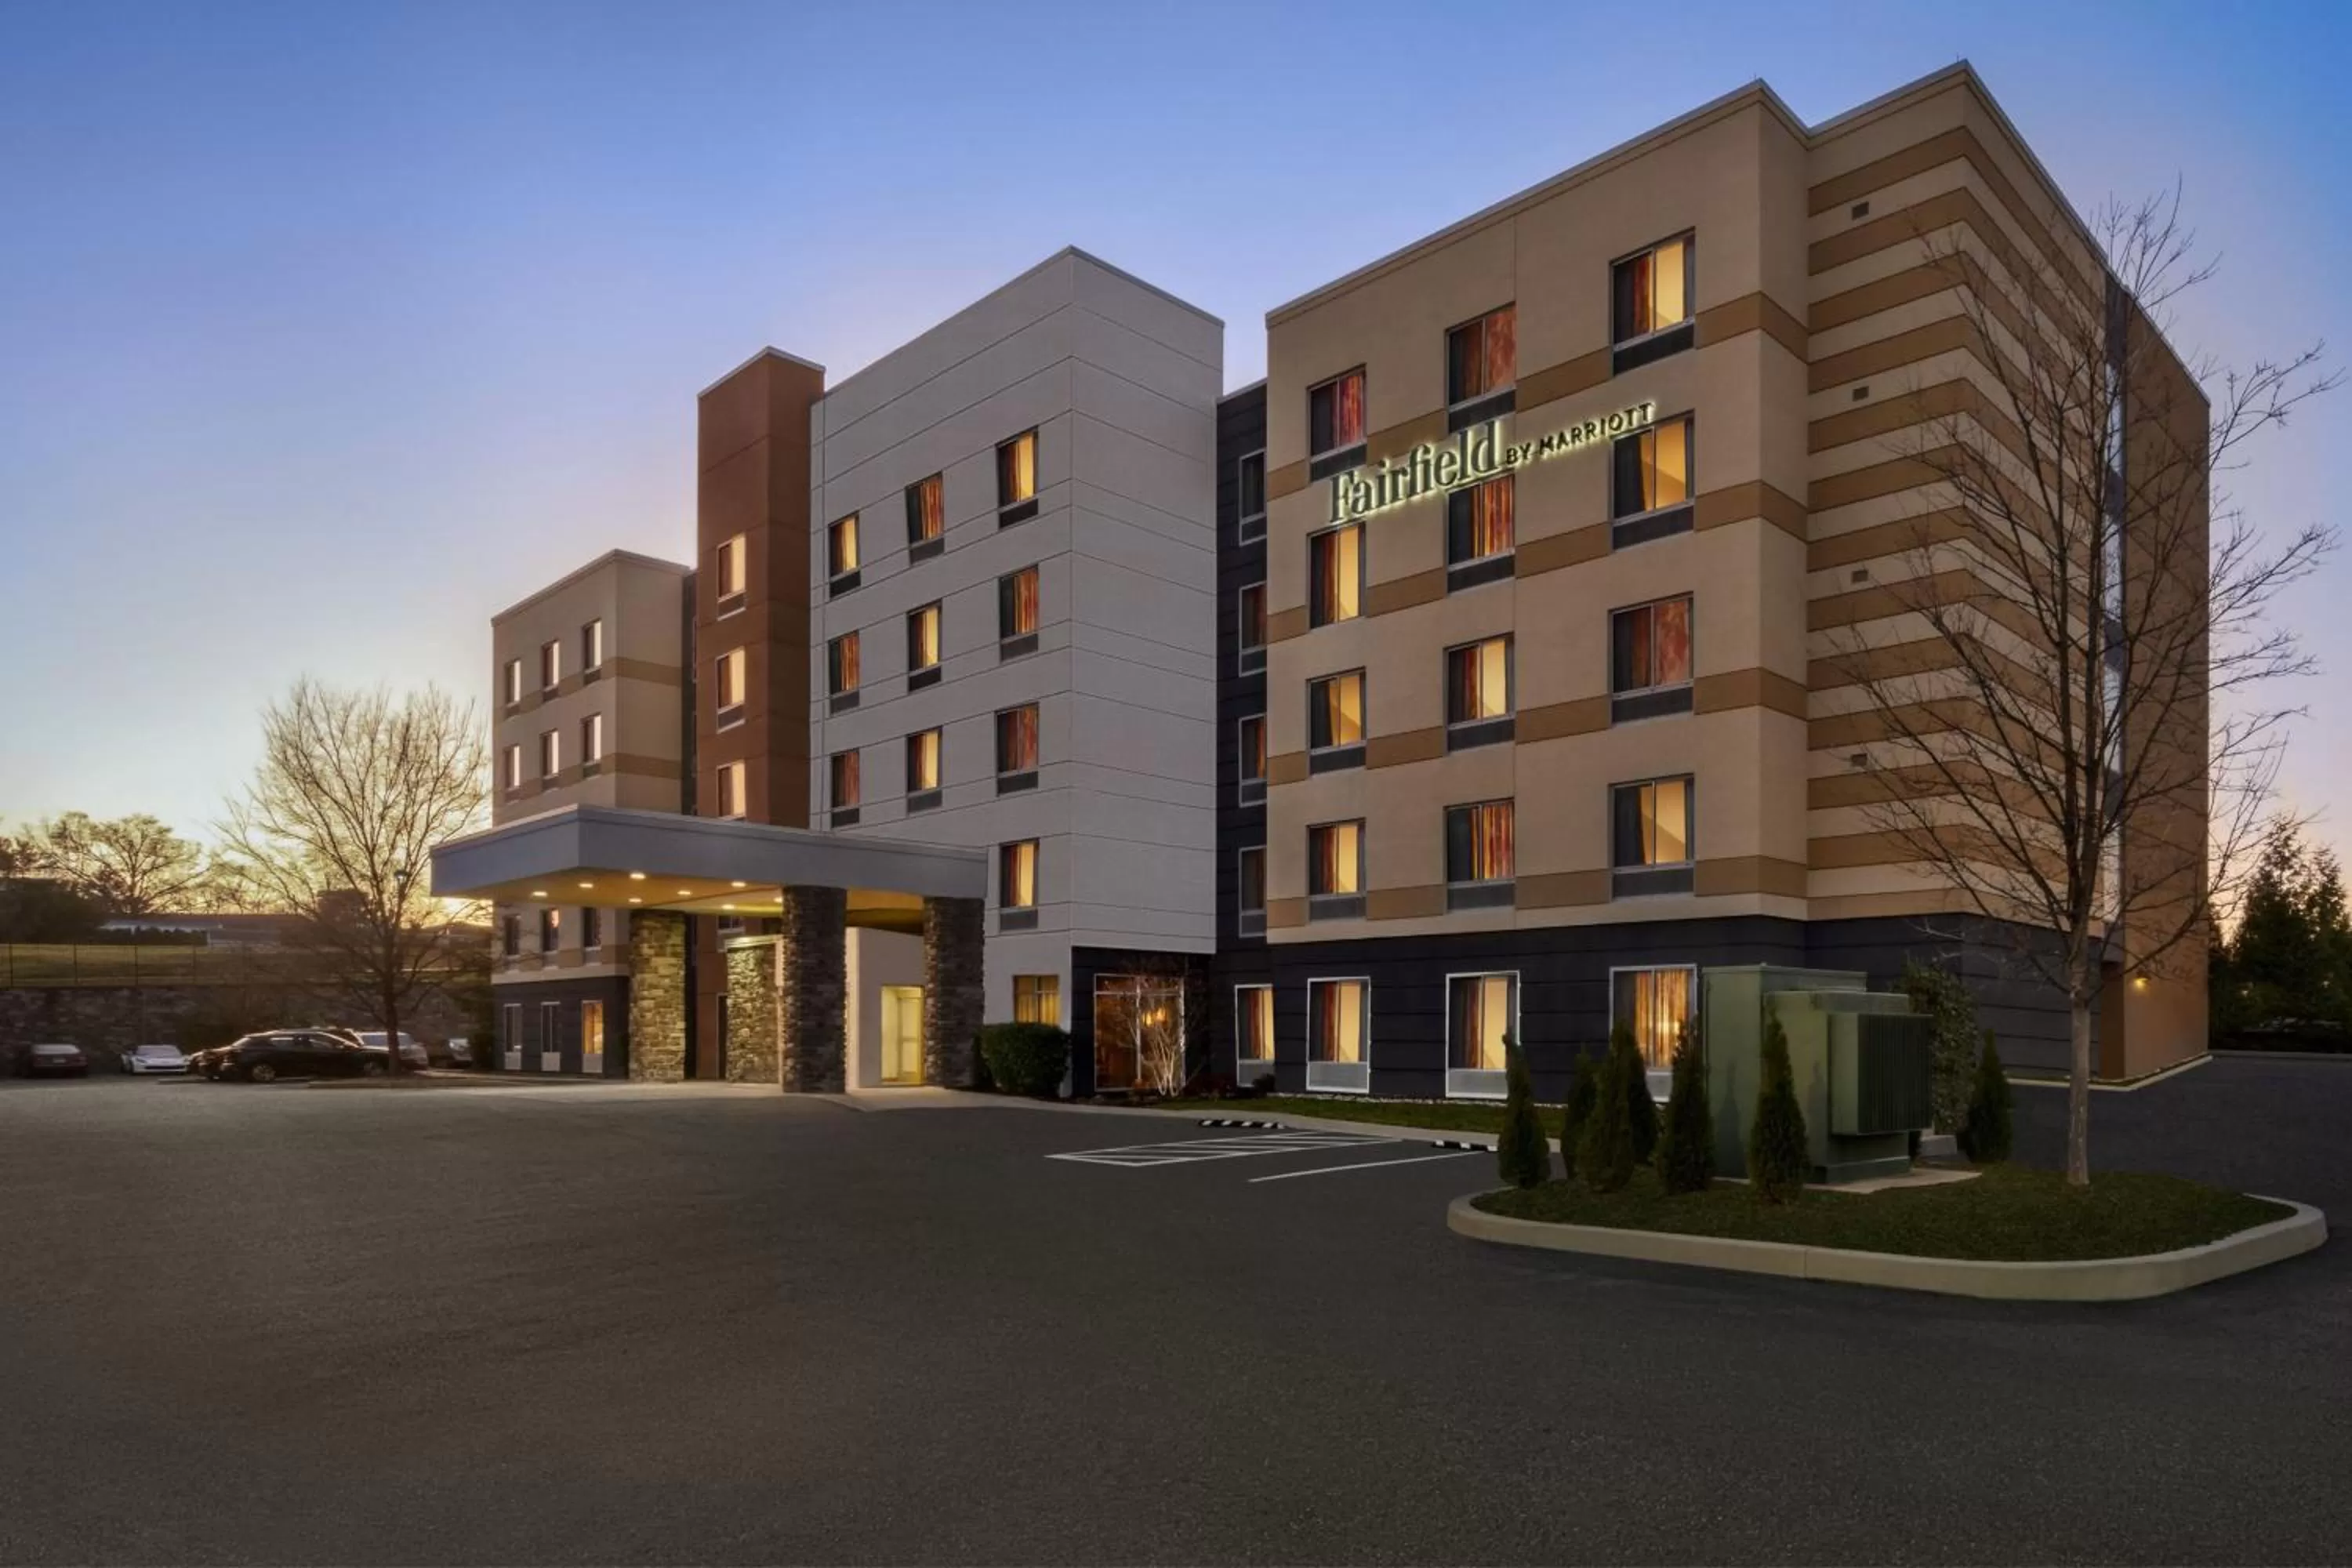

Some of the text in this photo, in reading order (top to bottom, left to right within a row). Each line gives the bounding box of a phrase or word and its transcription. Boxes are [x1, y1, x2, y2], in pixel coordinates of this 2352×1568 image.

[1330, 402, 1653, 523] Fairfield BY MARRIOTT
